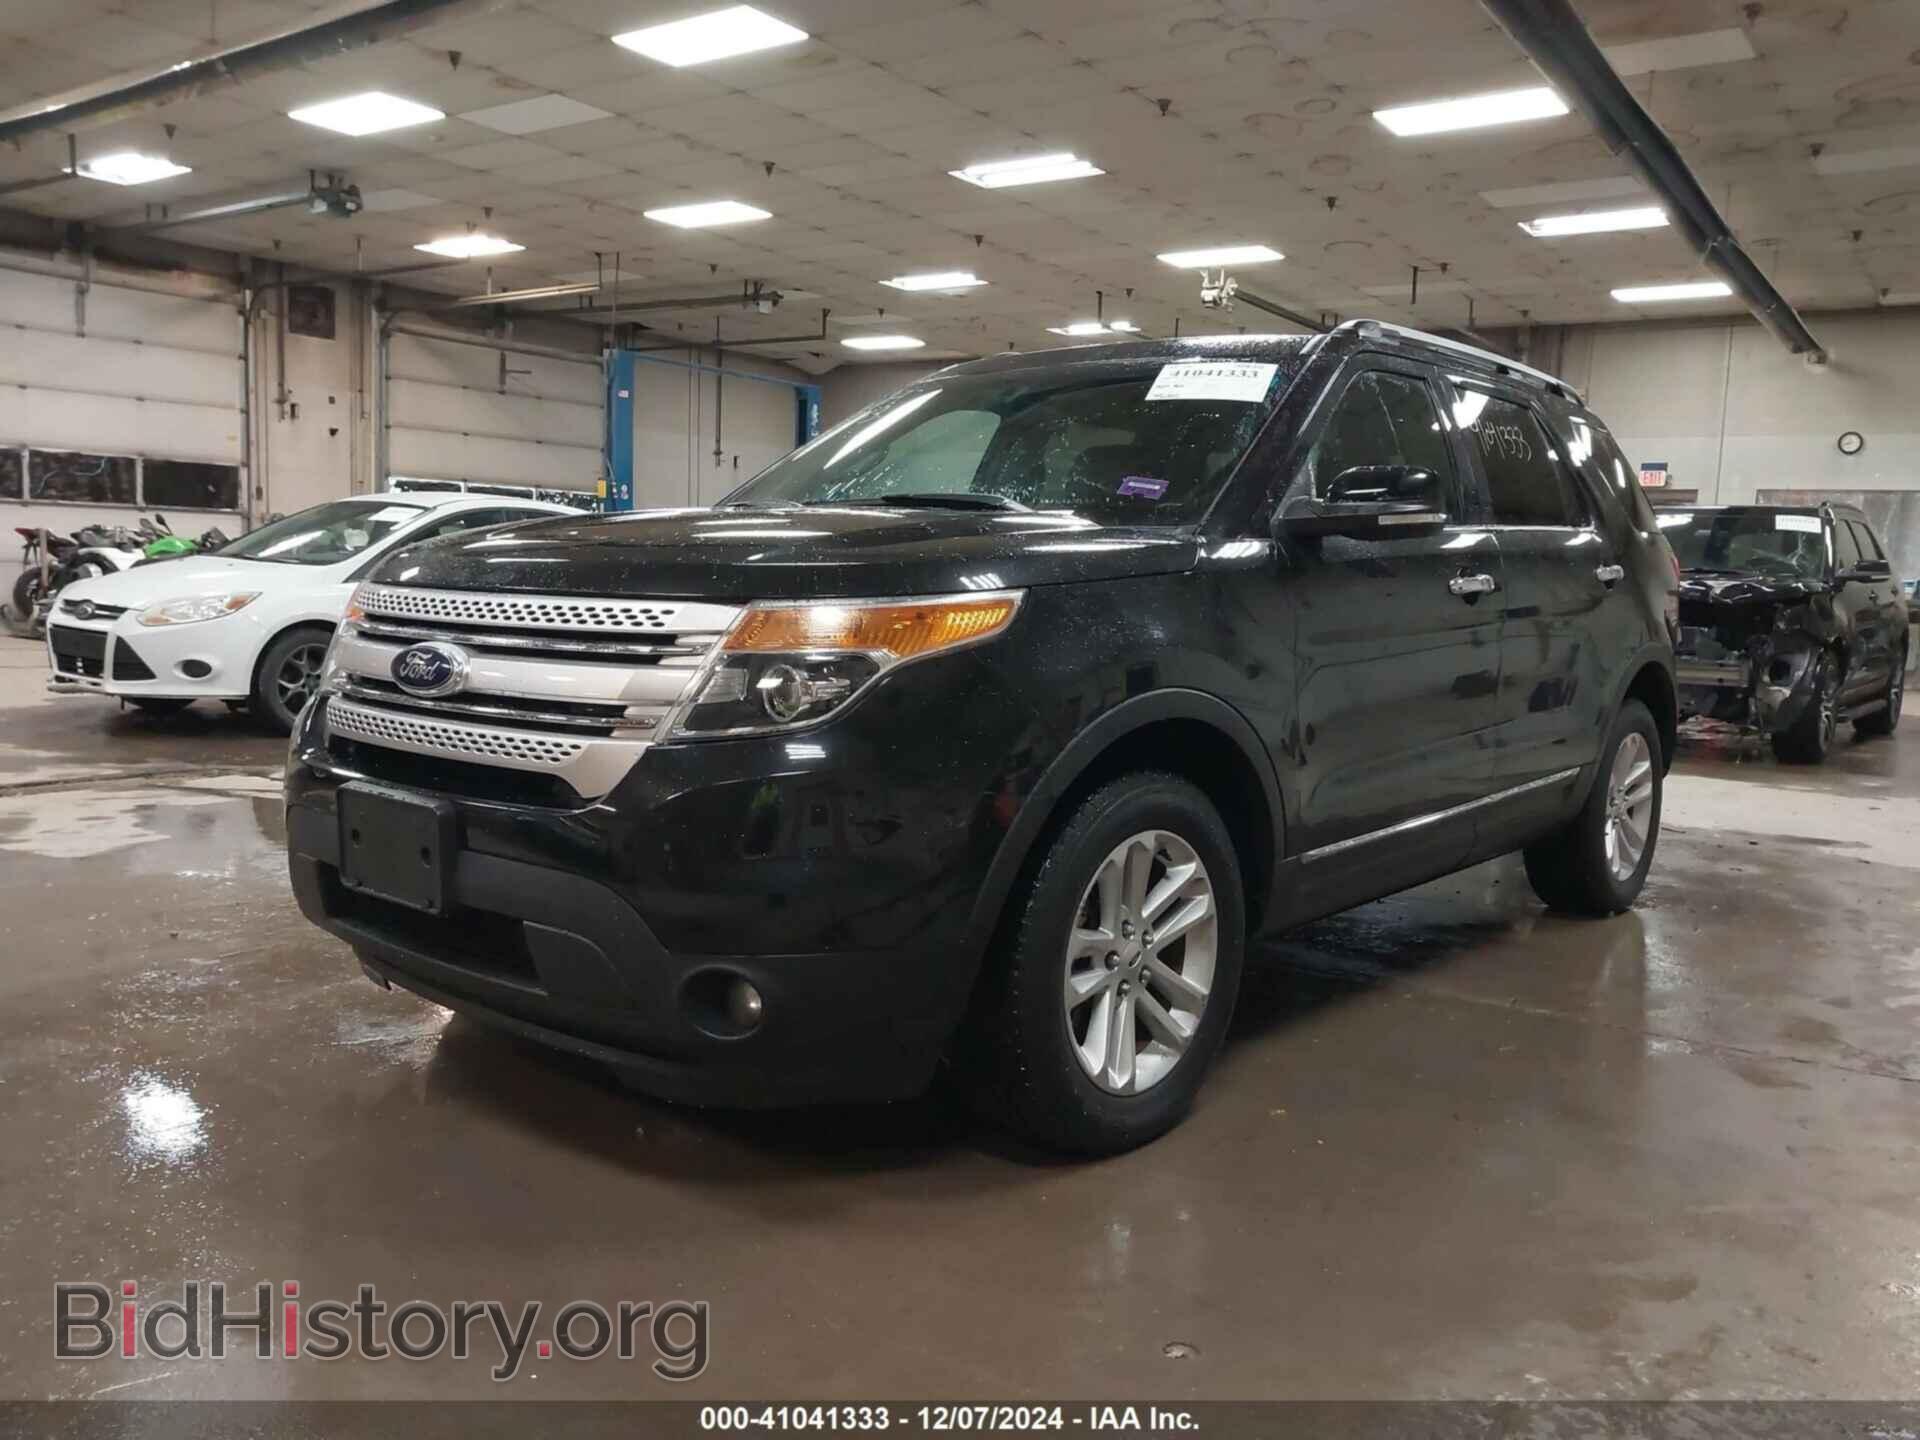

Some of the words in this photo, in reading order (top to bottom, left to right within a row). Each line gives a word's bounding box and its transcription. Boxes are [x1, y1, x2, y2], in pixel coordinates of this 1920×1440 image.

[1168, 369, 1259, 378] 41041333
[1642, 471, 1662, 485] EXIT
[399, 651, 441, 680] Ford
